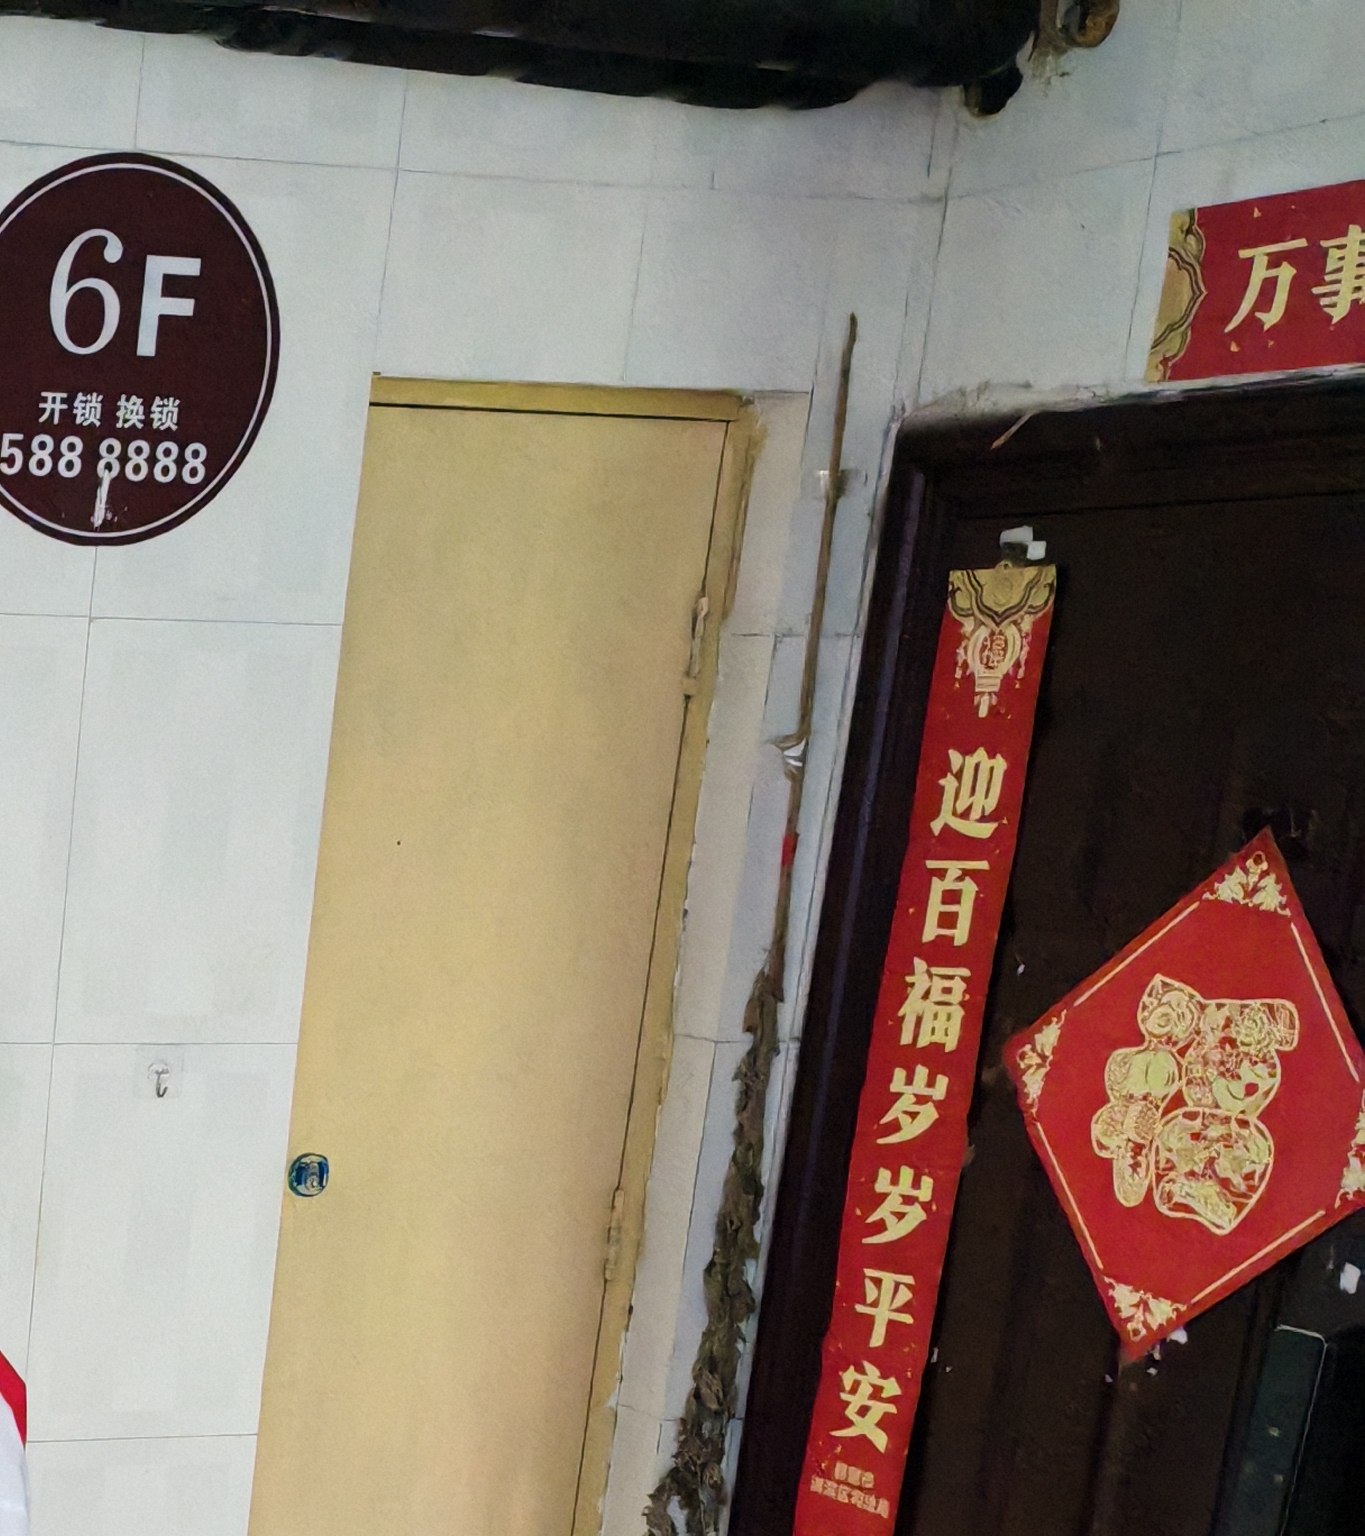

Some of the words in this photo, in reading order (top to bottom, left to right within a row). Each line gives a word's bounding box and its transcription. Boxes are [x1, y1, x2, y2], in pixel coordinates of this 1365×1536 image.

[48, 227, 202, 358] 6F
[38, 390, 103, 427] 开锁
[115, 393, 181, 431] 换锁
[0, 432, 84, 478] 588
[96, 437, 208, 485] 8888
[836, 746, 1009, 1456] 迎百福岁岁平安
